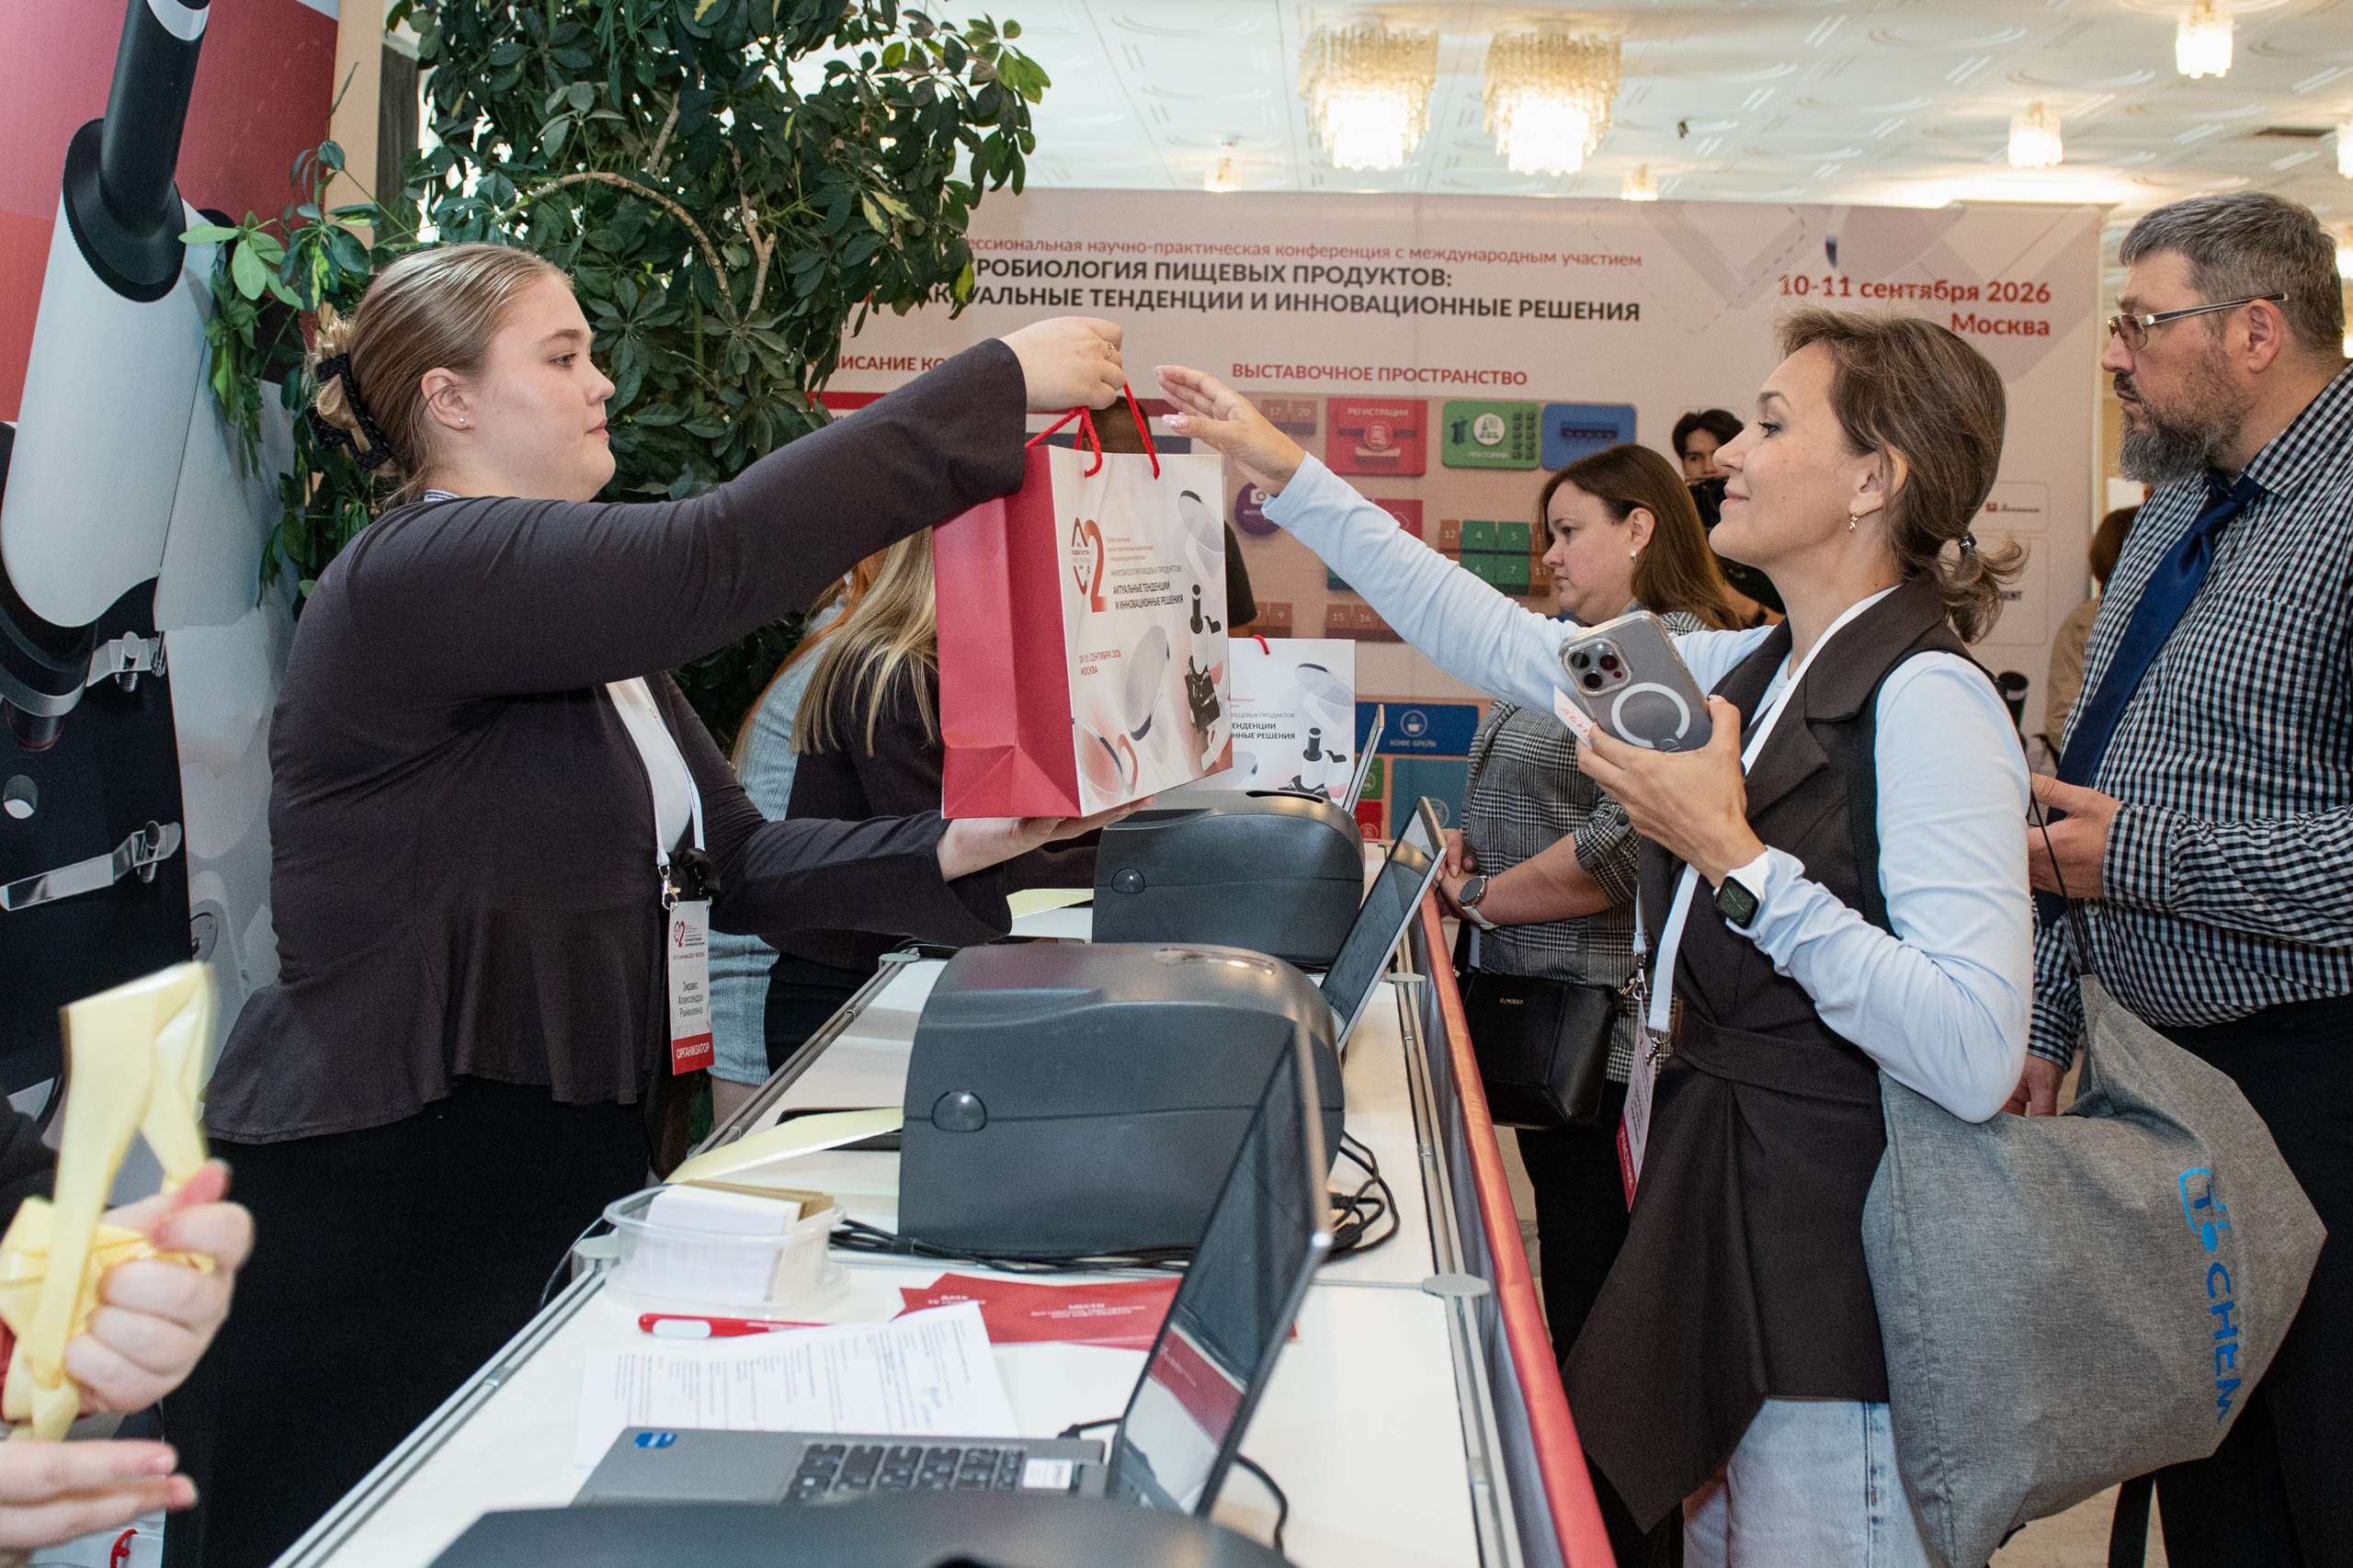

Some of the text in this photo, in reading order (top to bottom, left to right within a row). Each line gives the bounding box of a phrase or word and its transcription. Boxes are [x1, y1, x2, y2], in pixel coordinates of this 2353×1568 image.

[1087, 241, 1270, 256] научно-практическая
[1275, 244, 1391, 260] конференция
[1395, 248, 1404, 258] с
[1409, 248, 1556, 265] международным
[1561, 252, 1643, 267] участием
[975, 259, 1452, 288] РОБИОЛОГИЯ ПИЩЕВЫХ ПРОДУКТОВ:
[1779, 275, 2052, 304] 10-11 сентября 2026
[1089, 289, 1243, 312] ТЕНДЕНЦИИ
[1251, 292, 1267, 311] И
[1274, 293, 1512, 317] ИННОВАЦИОННЫЕ
[1518, 299, 1641, 321] РЕШЕНИЯ
[1950, 312, 2051, 336] Москва
[1233, 364, 1528, 385] ВЫСТАВОЧНОЕ ПРОСТРАНСТВО
[1445, 530, 1456, 540] 12
[1113, 581, 1170, 596] АКТУАЛЬНЫЕ ТЕНДЕНЦИИ
[1120, 596, 1160, 610] ИННОВАЦИОННЫЕ
[1161, 594, 1184, 606] РЕШЕНИЯ
[676, 1041, 710, 1060] ОРГАНИЗАТОР
